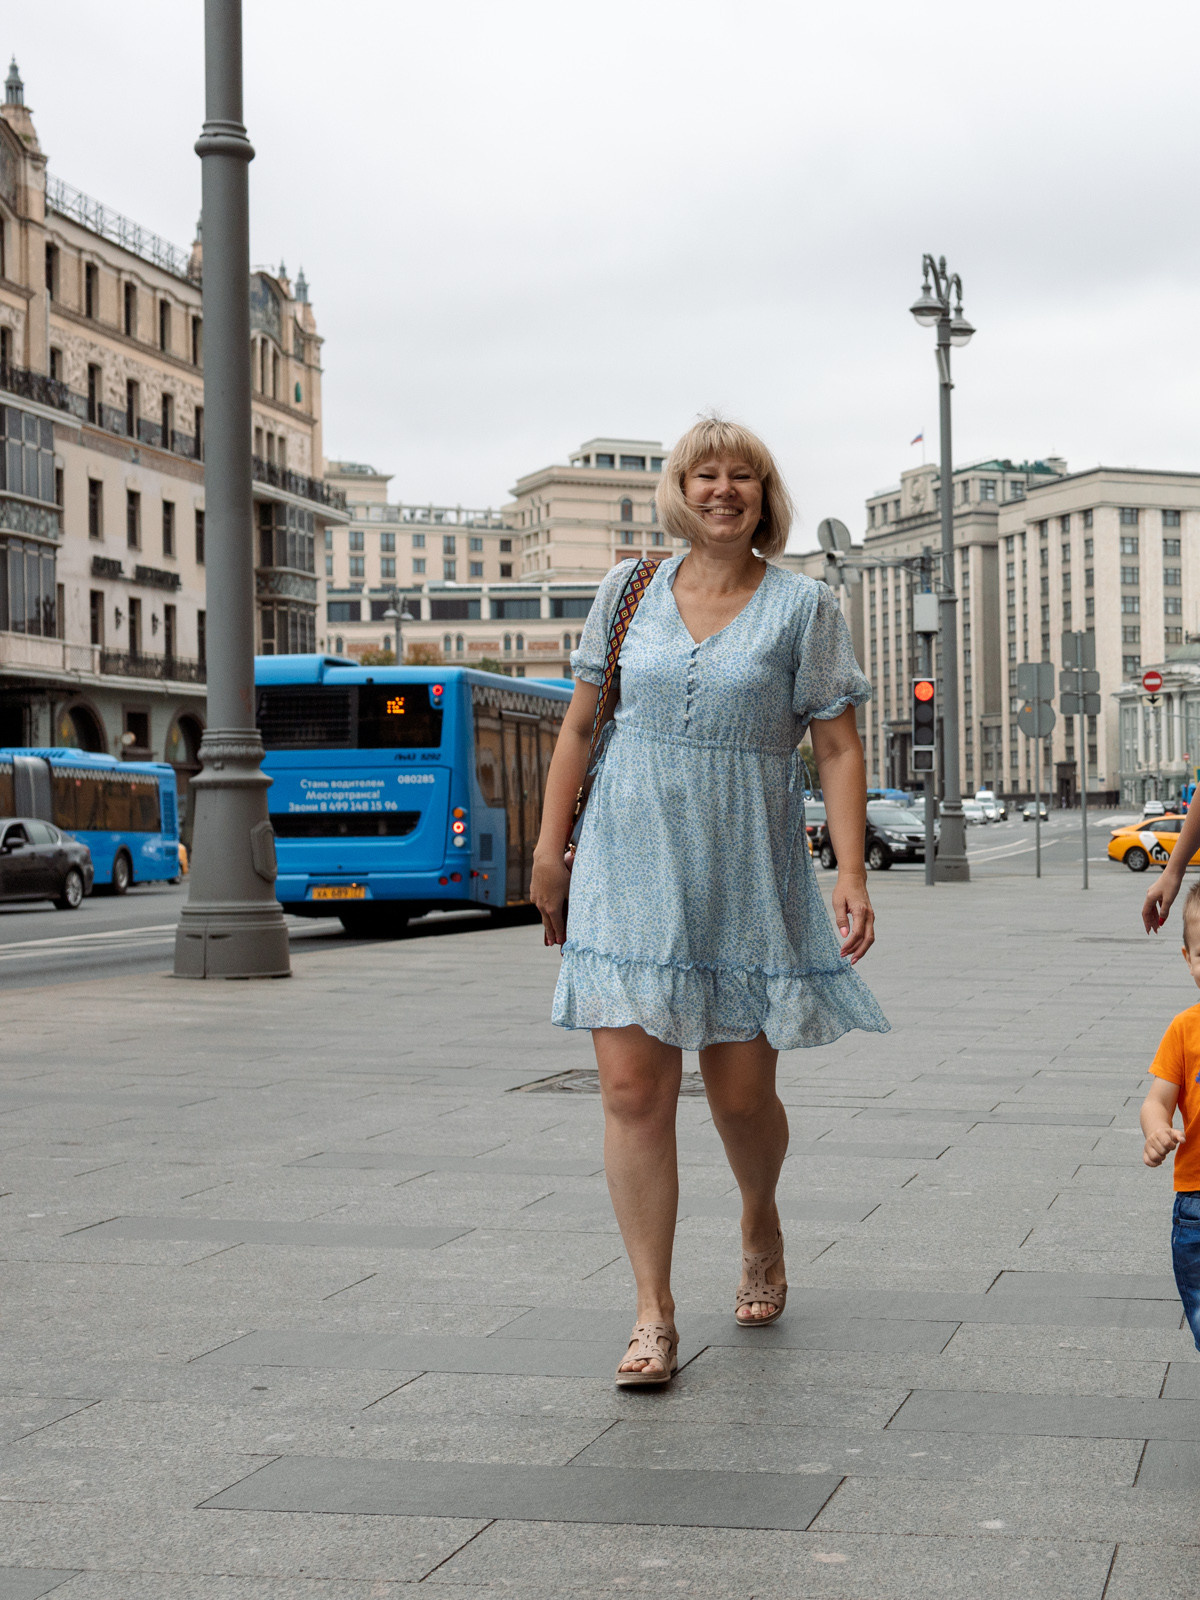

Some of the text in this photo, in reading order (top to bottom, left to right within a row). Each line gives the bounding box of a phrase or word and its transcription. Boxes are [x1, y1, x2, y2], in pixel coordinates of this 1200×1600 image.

[300, 778, 385, 789] Стань водителем
[397, 774, 435, 784] 080285
[305, 789, 380, 801] Мосгортранса!
[288, 800, 398, 812] Звони 8 499 148 15 96
[1152, 846, 1170, 861] Go
